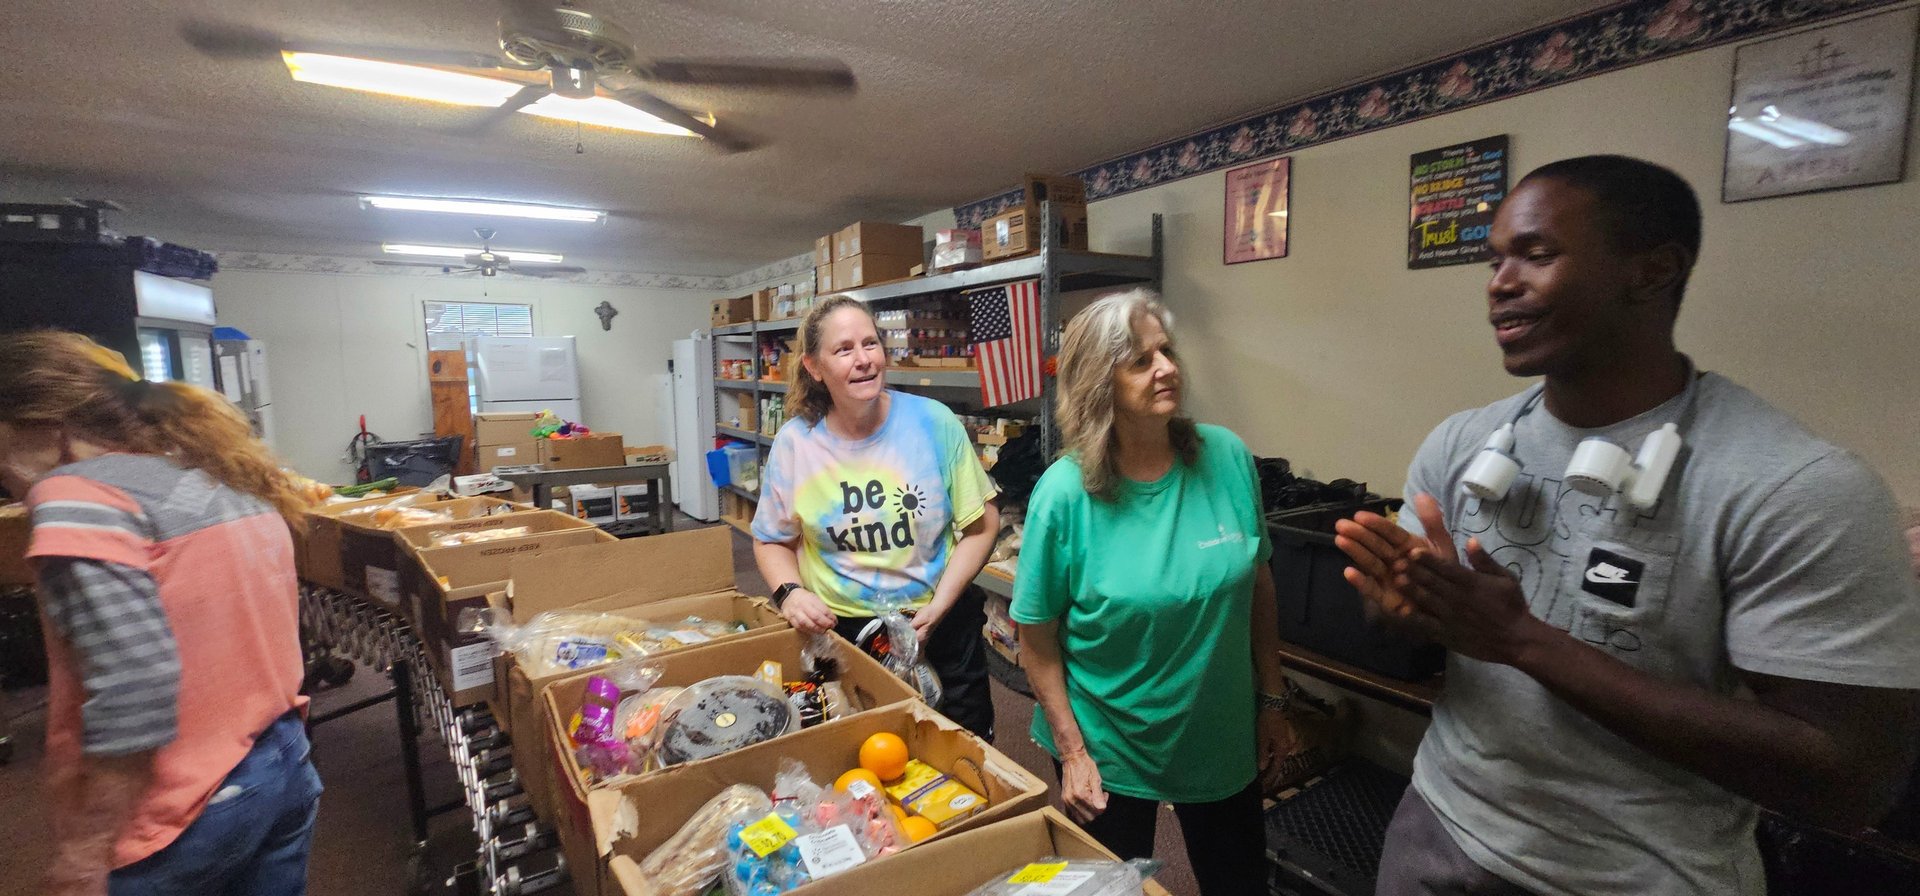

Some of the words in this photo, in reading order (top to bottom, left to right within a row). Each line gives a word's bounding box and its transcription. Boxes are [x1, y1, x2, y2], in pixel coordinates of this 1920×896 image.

[1482, 149, 1503, 160] God
[1412, 184, 1429, 198] NO
[1481, 169, 1502, 182] God
[1482, 190, 1503, 202] God
[1414, 219, 1459, 249] Trust
[840, 479, 886, 514] be
[826, 511, 914, 553] kind
[517, 542, 541, 553] KEEP
